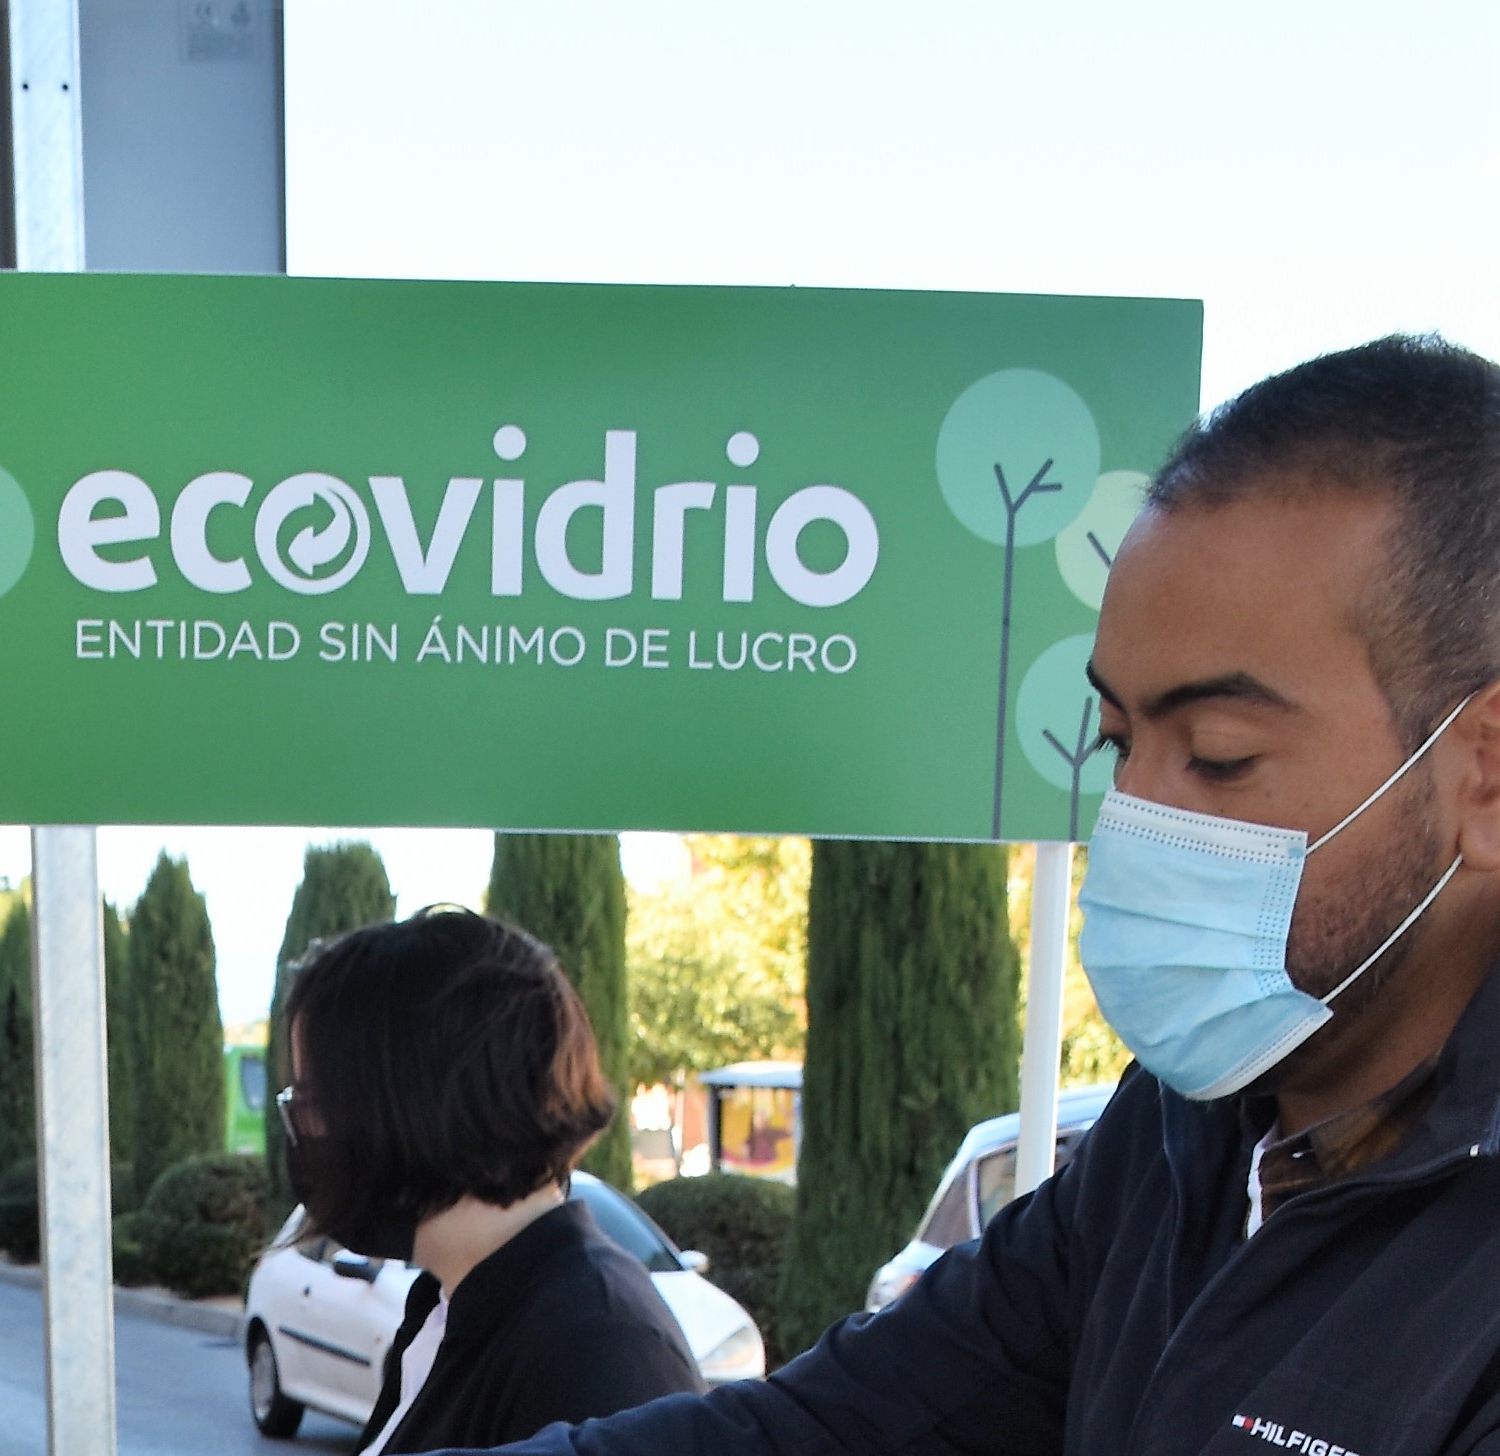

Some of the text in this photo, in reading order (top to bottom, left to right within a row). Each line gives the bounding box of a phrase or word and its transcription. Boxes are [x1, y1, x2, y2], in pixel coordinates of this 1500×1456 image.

[57, 425, 880, 607] ecovidrio
[76, 615, 857, 673] ENTIDAD SIN ÁNIMO DE LUCRO
